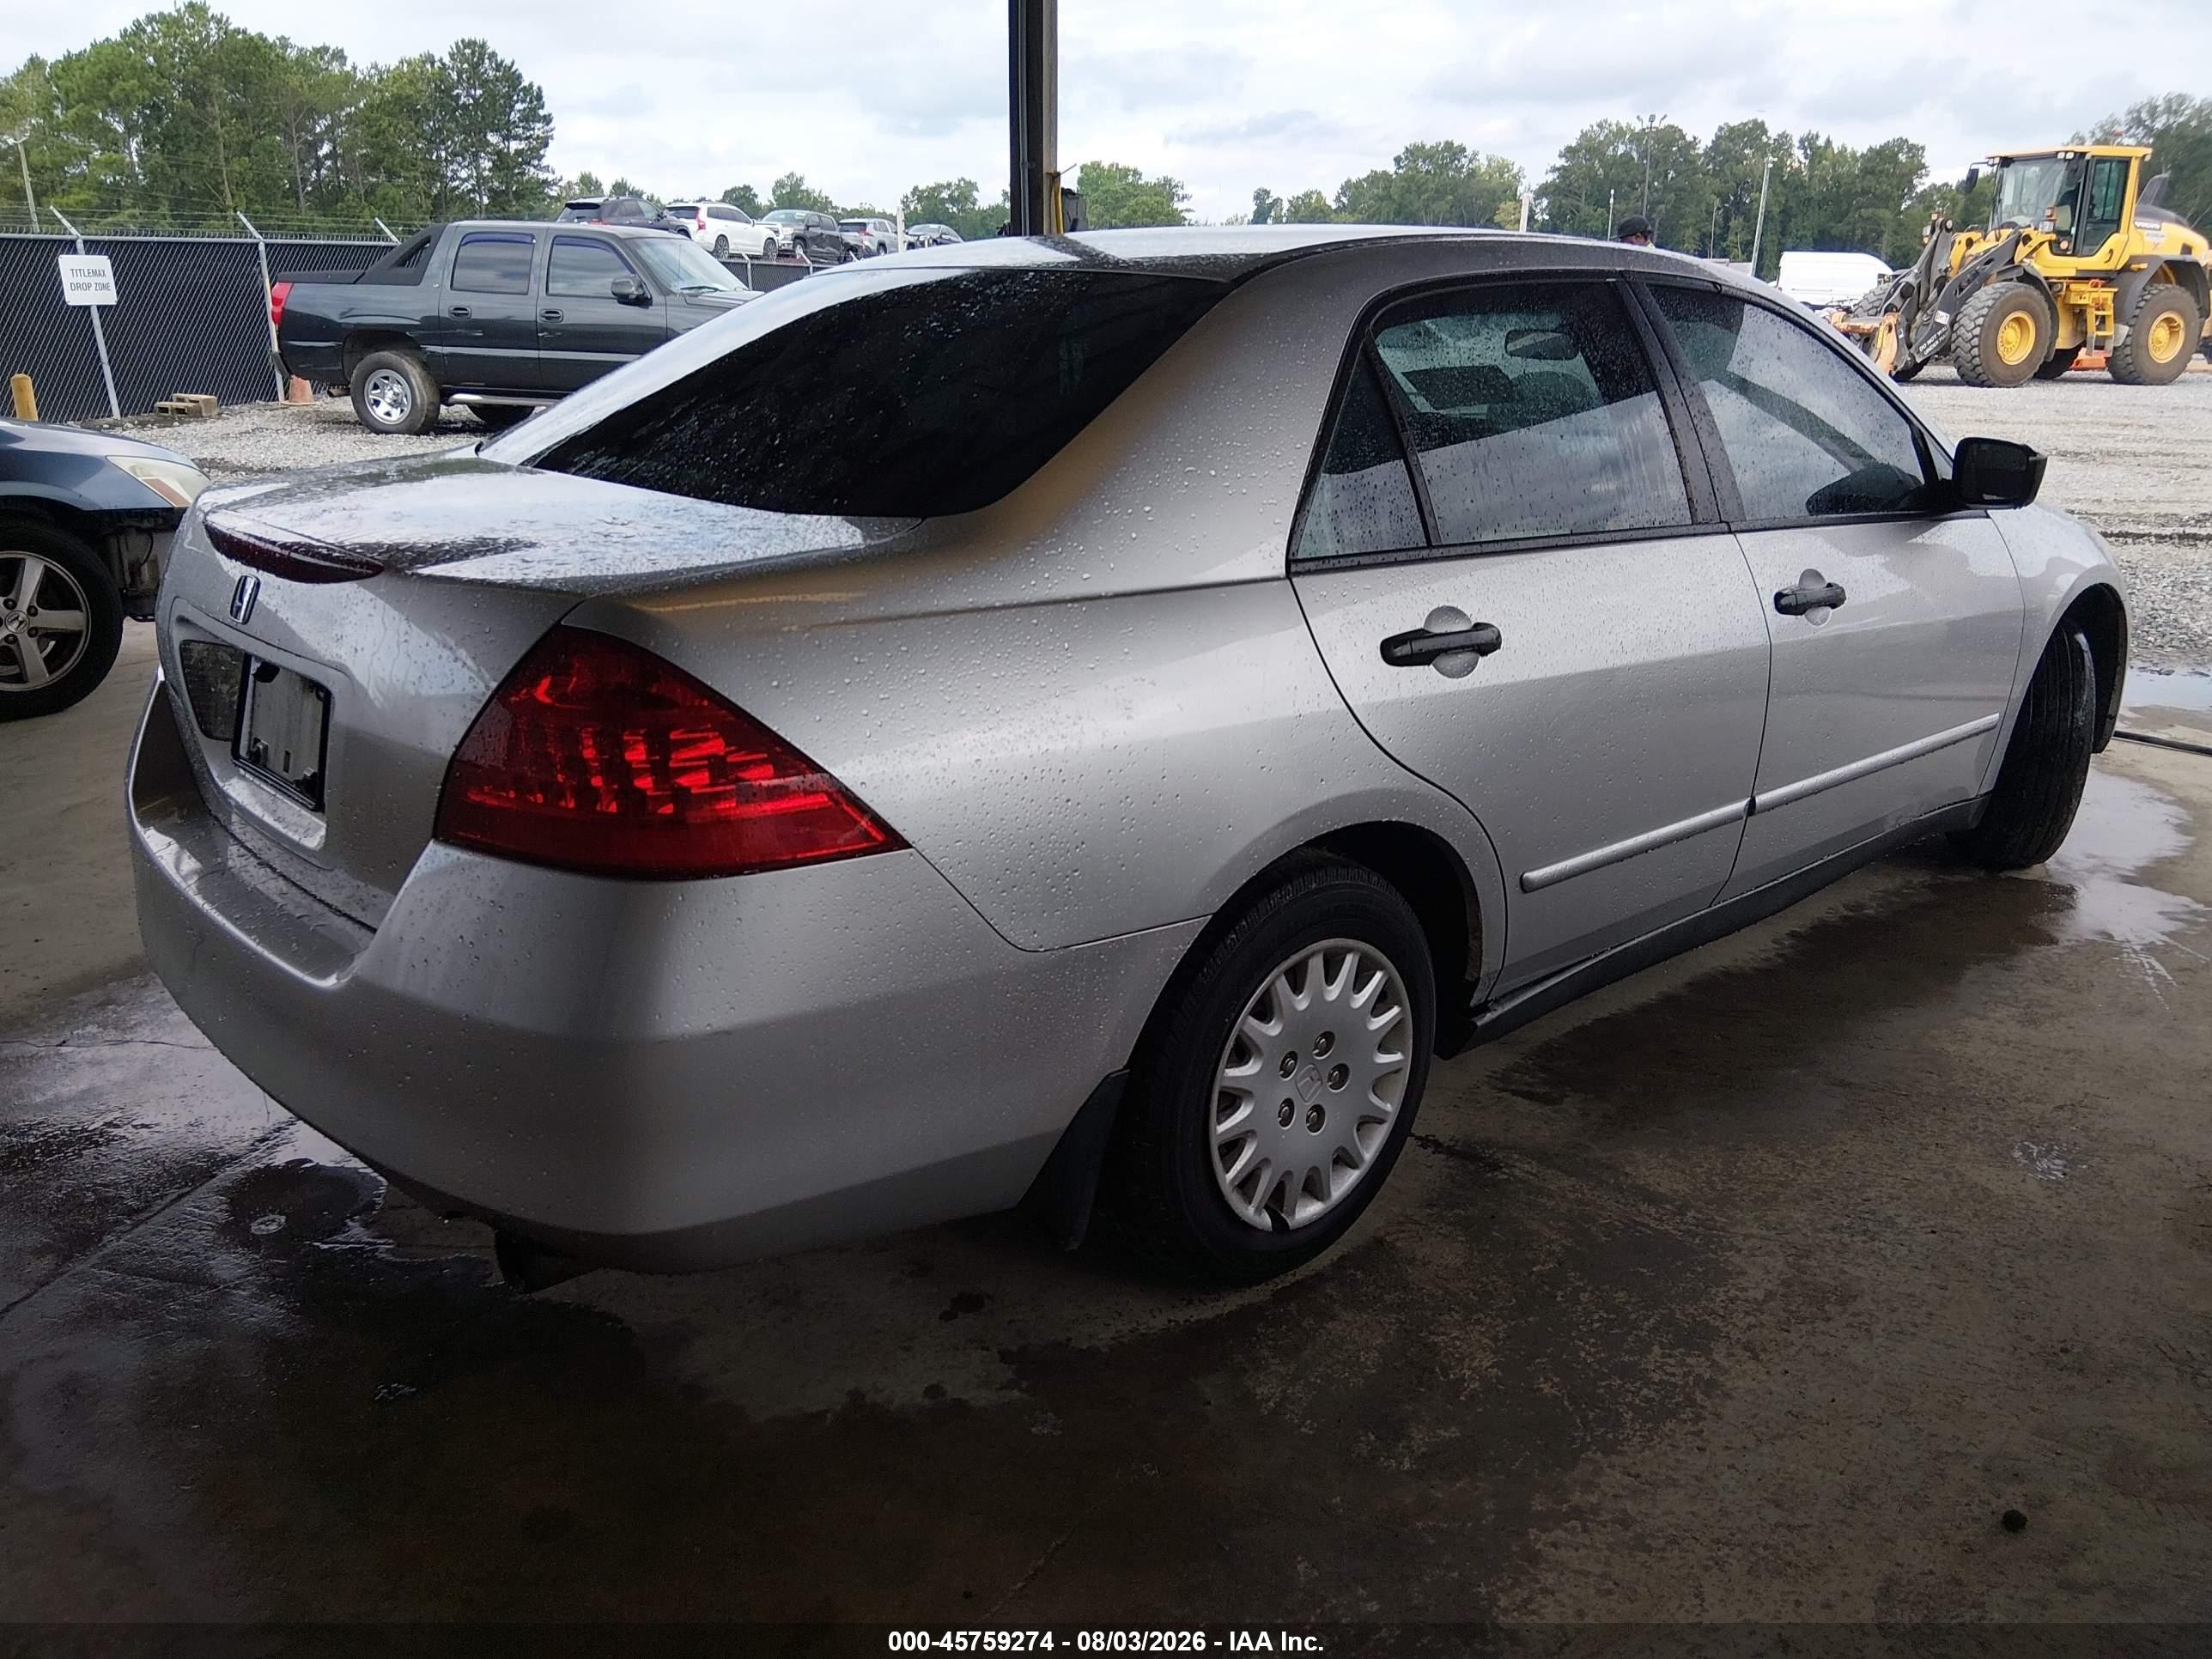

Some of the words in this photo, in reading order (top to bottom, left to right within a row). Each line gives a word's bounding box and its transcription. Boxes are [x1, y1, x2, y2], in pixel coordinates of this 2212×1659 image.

[70, 269, 106, 277] TITLEMAX
[70, 282, 92, 292] DROP
[94, 282, 111, 292] ZONE
[1919, 343, 1927, 352] DO
[1927, 333, 1937, 345] NOT
[1923, 340, 1939, 355] UNDER
